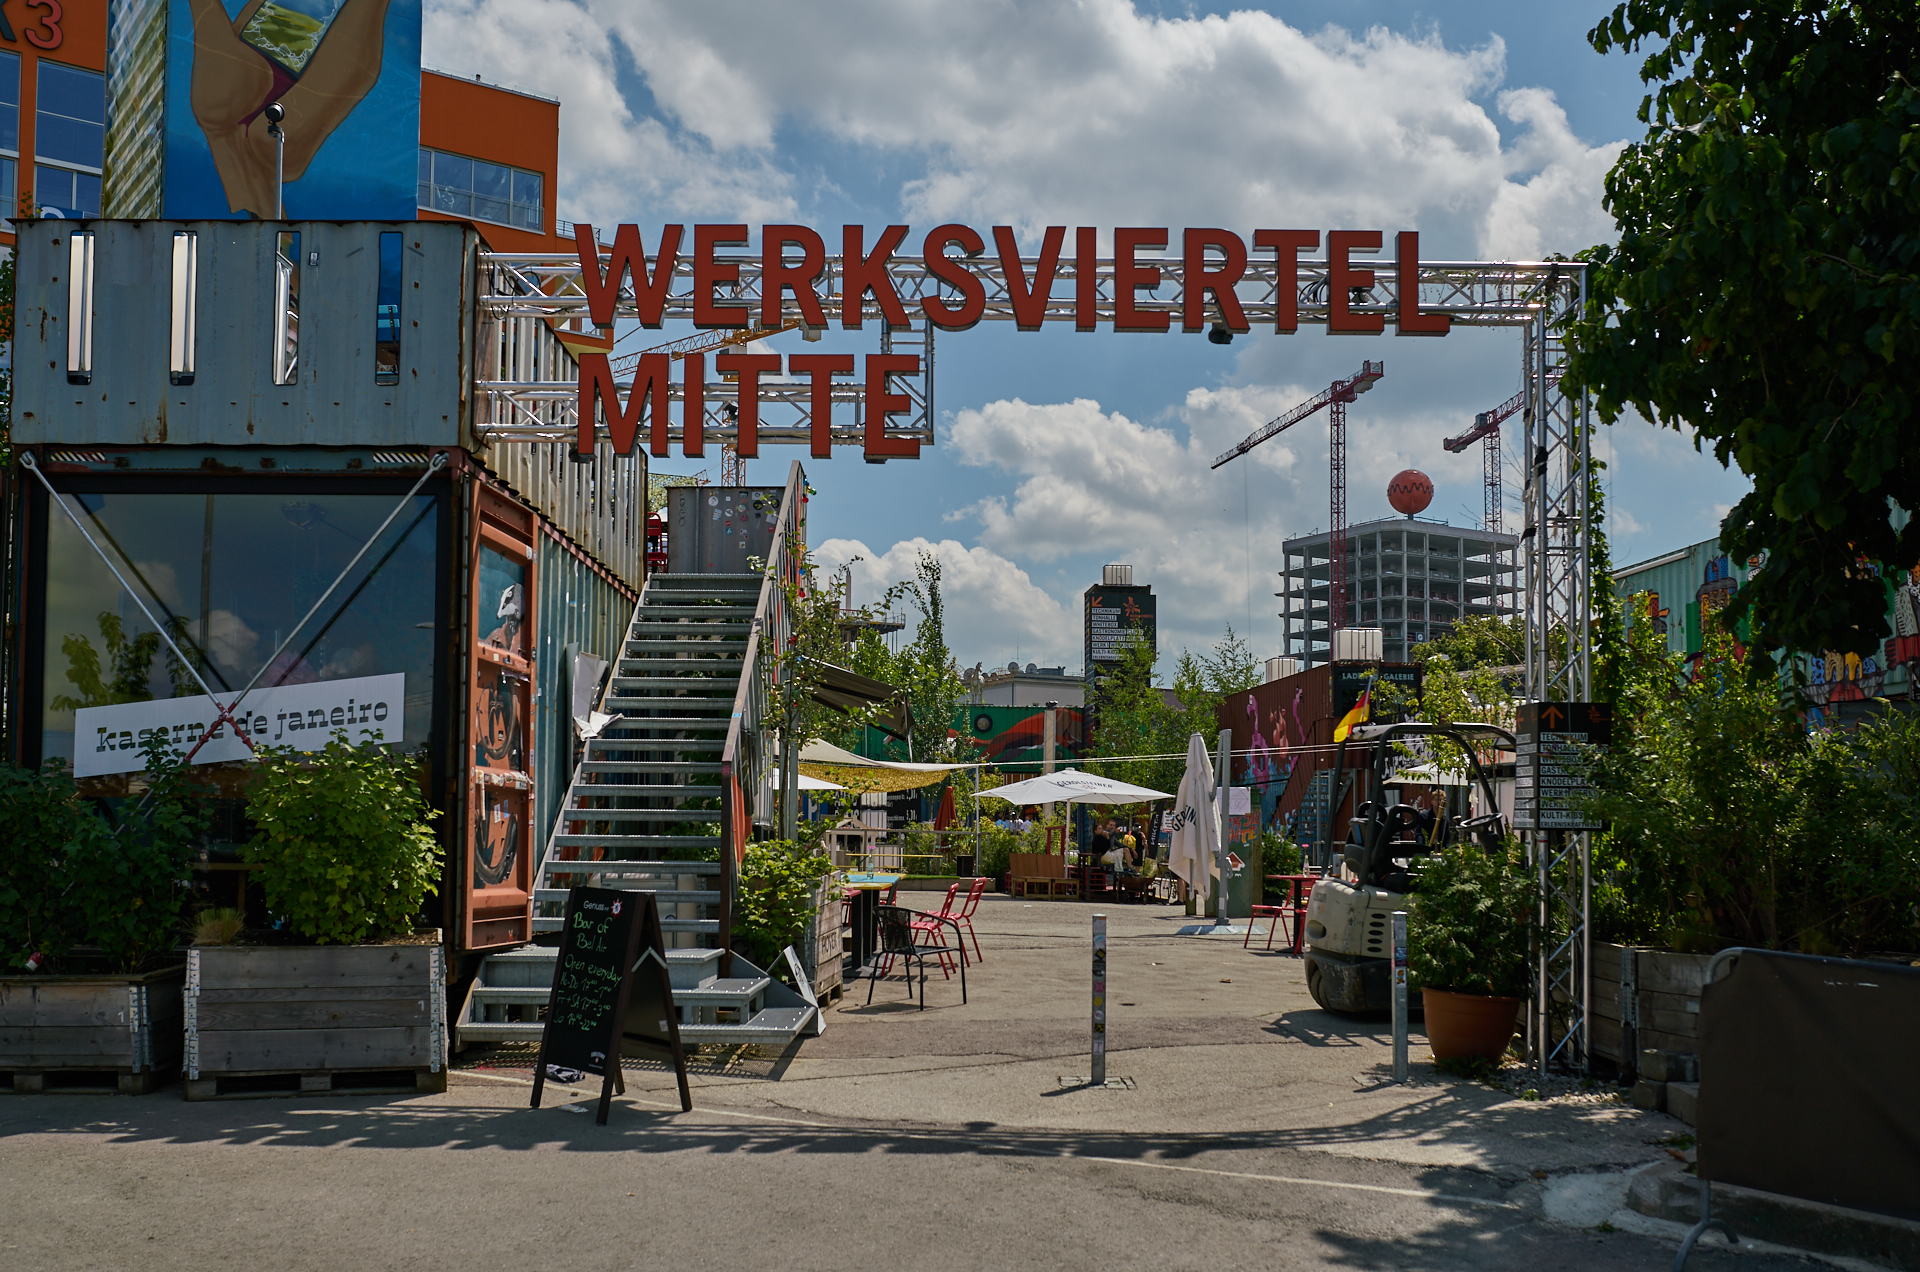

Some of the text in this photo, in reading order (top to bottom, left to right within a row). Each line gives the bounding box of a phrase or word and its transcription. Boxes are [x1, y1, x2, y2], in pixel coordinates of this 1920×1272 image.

[574, 223, 1450, 337] WERKSVIERTEL
[577, 353, 920, 460] MITTE
[96, 698, 388, 752] kaserne de janeiro
[1541, 811, 1583, 819] KULTI-KIDS
[572, 911, 613, 934] Bar of
[576, 932, 596, 951] Bel
[565, 953, 623, 988] Open everyday
